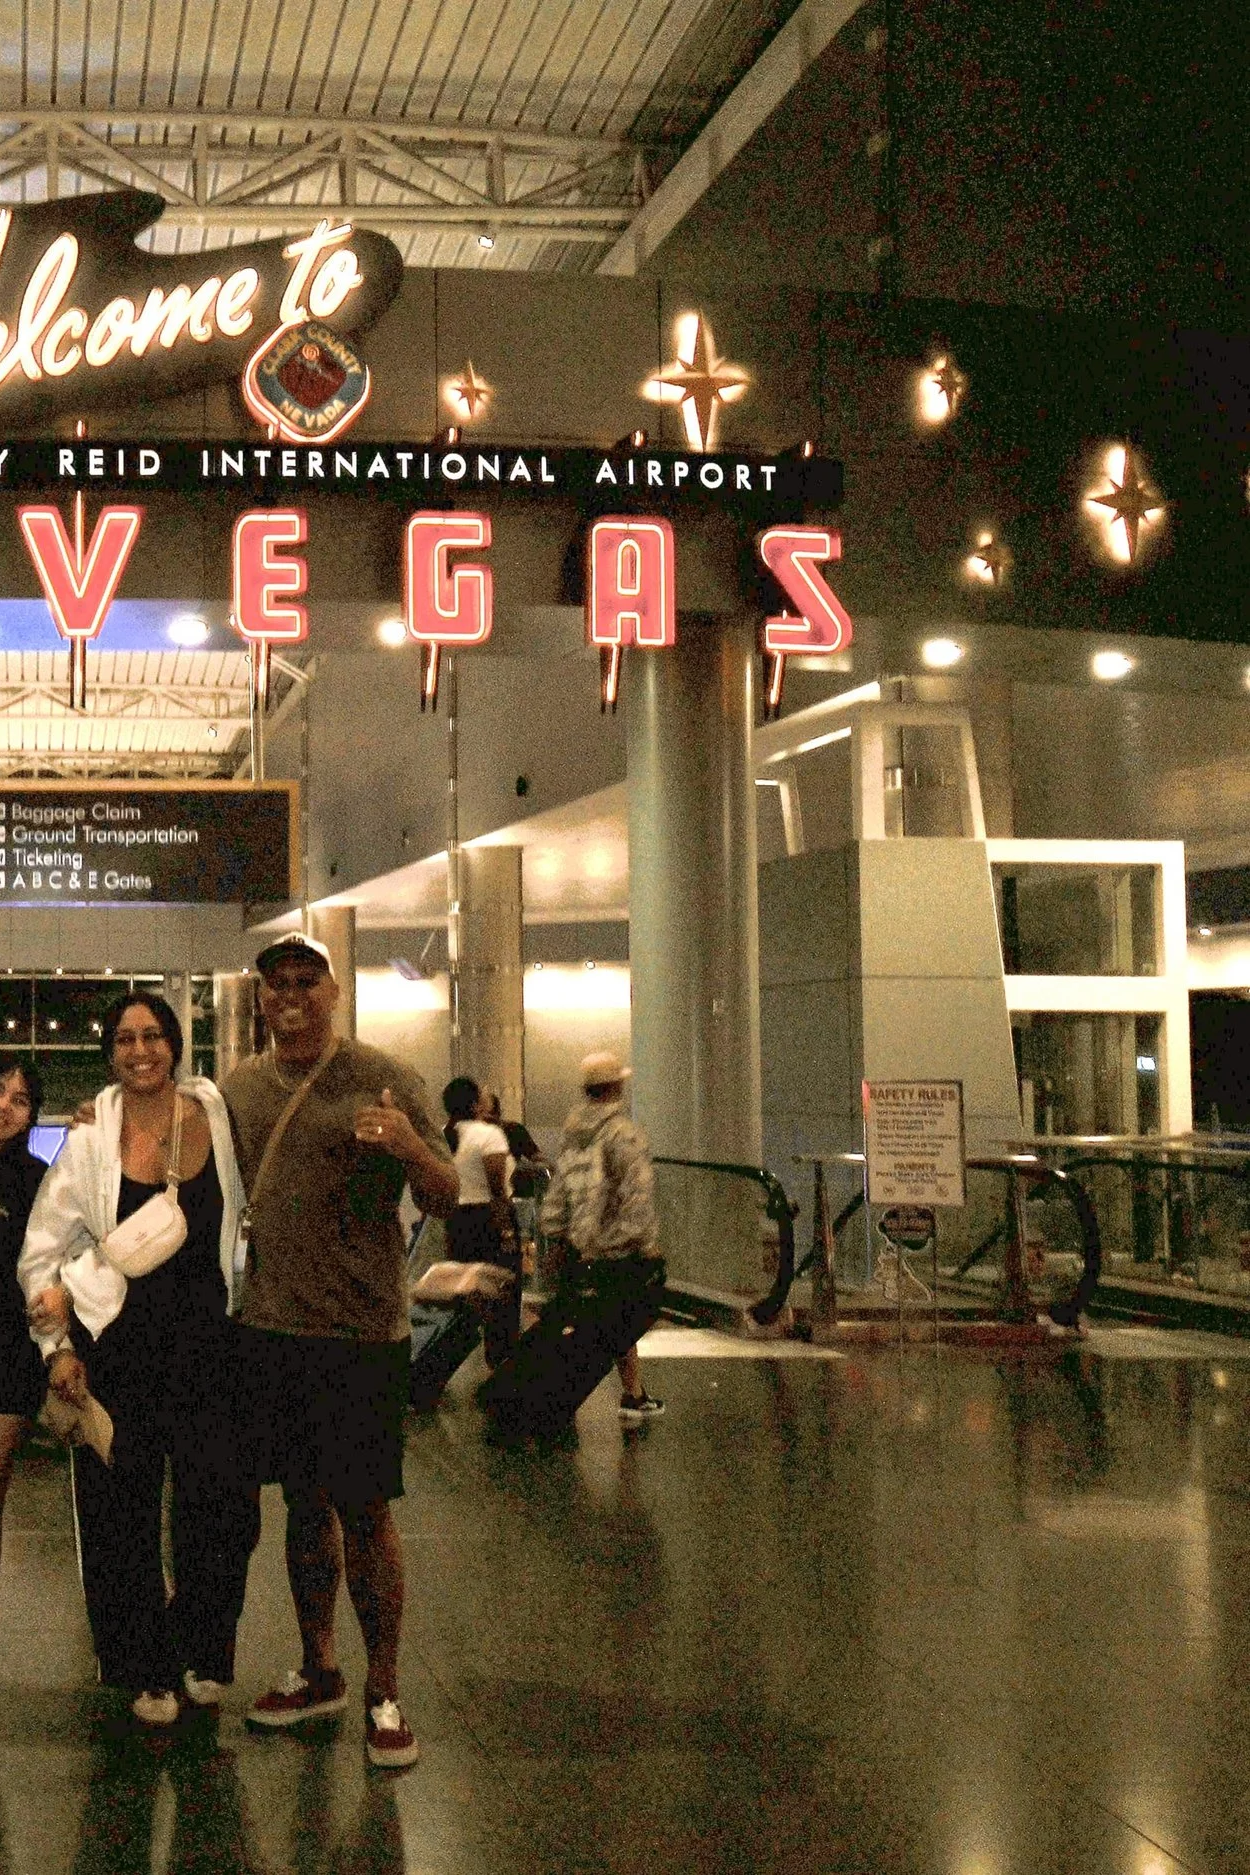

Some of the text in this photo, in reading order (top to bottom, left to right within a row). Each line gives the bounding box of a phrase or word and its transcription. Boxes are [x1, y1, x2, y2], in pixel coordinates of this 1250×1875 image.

[280, 218, 363, 322] to
[280, 399, 347, 427] NEVADA
[58, 447, 162, 477] REID
[201, 448, 556, 484] INTERNATIONAL
[594, 457, 778, 492] AIRPORT
[18, 505, 853, 654] VEGAS
[11, 802, 141, 824] Baggage Claim
[12, 824, 199, 847] Ground Transportation
[12, 848, 83, 870] Ticketing
[12, 870, 152, 890] A B C & E Gates
[869, 1087, 956, 1101] SAFETY RULES
